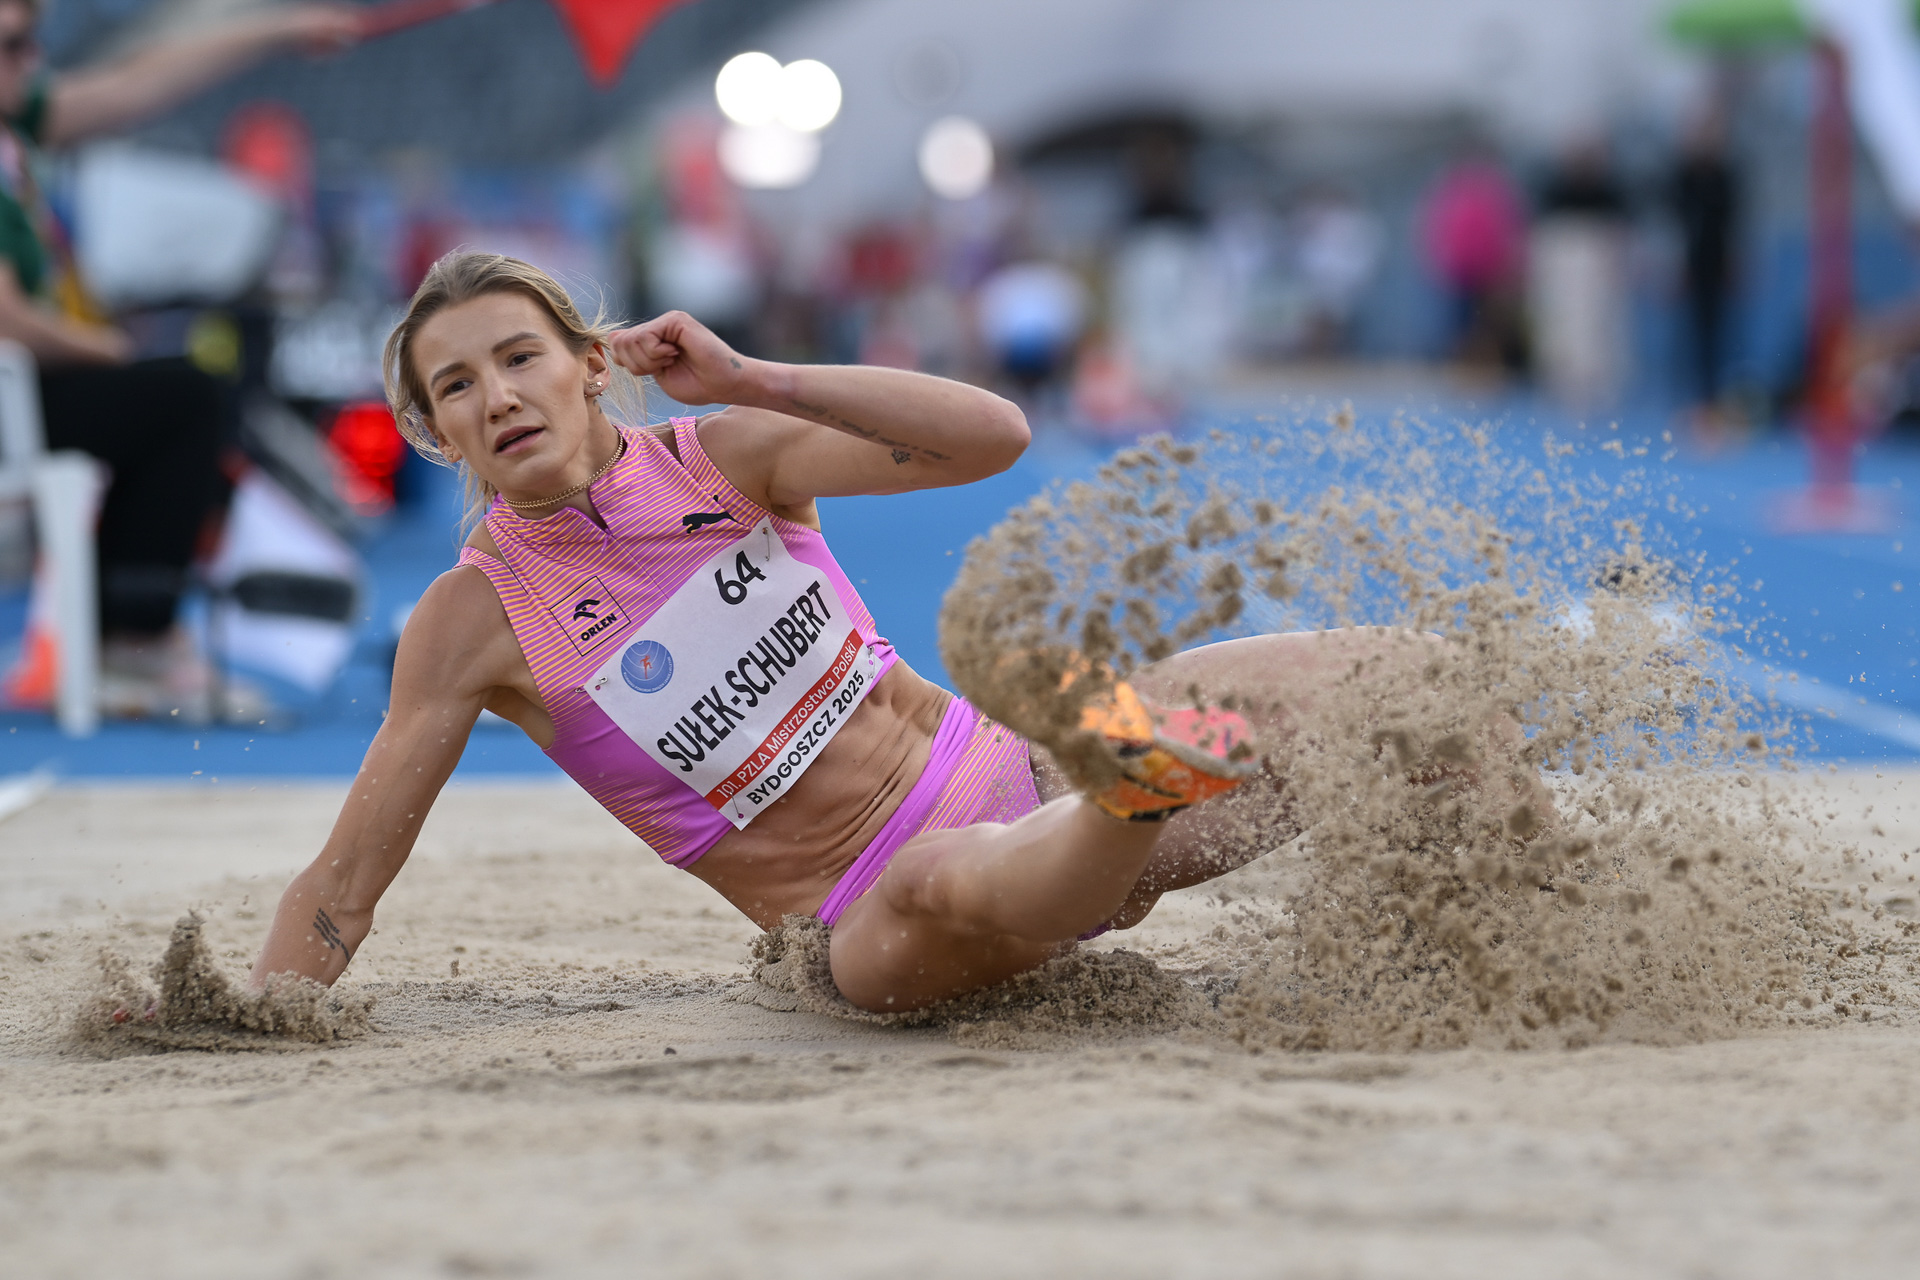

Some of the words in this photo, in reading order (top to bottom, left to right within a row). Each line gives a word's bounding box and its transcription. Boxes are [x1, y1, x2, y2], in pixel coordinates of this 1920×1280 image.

[581, 613, 617, 641] ORLEN
[714, 550, 767, 605] 64
[657, 581, 832, 772] SUŁEK-SCHUBERT
[716, 780, 742, 798] 101.
[736, 751, 771, 783] PZLA
[766, 678, 836, 754] Mistrzostwa
[832, 640, 857, 680] Polski
[746, 709, 837, 805] BYDGOSZCZ
[832, 670, 864, 715] 2025
